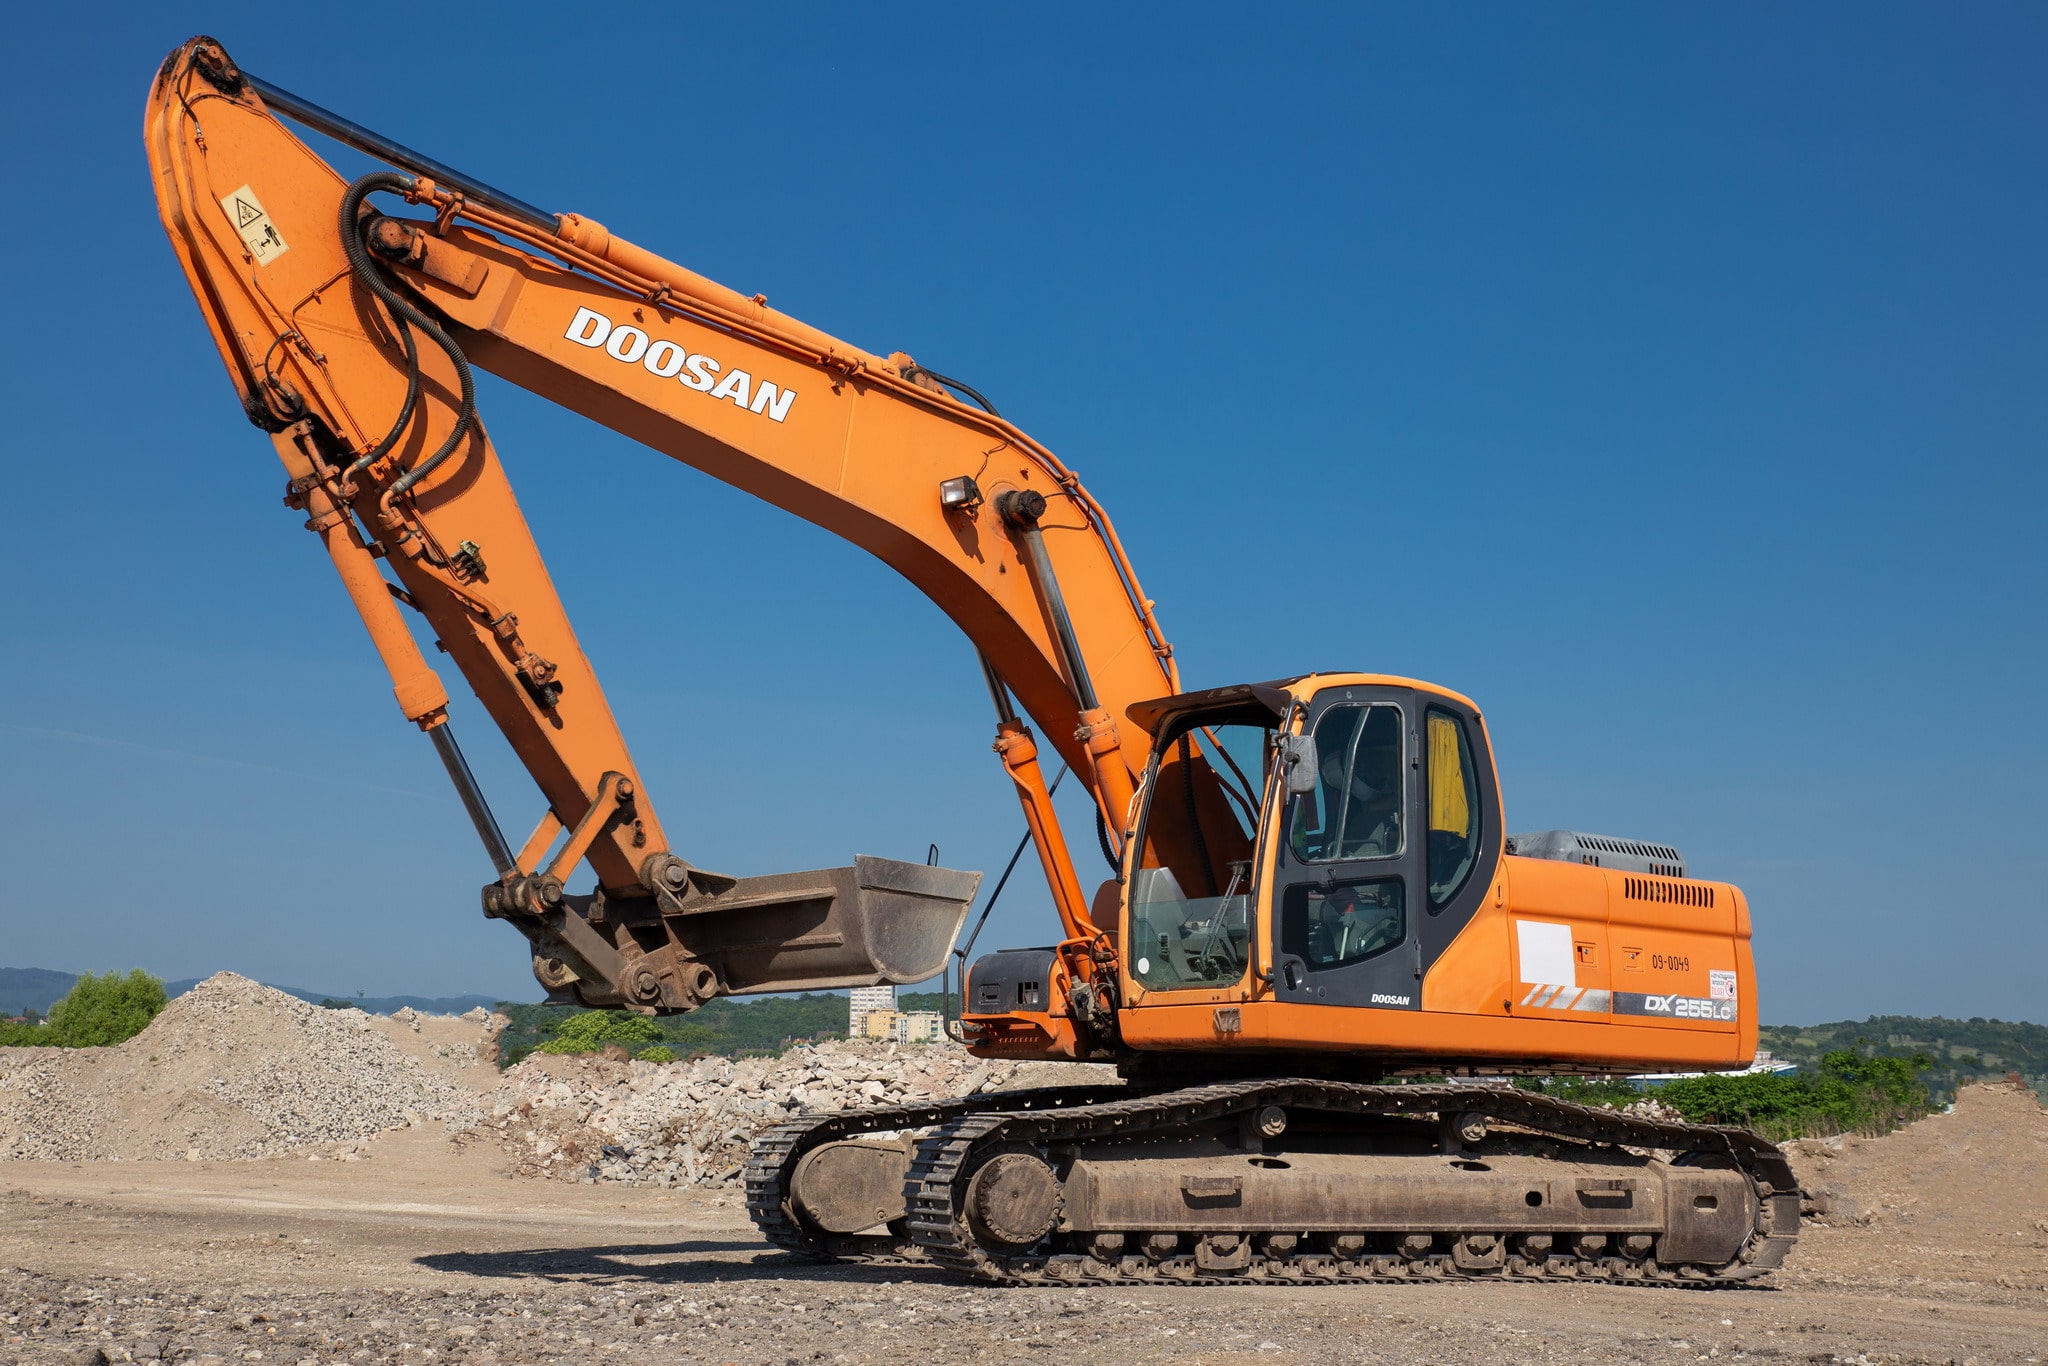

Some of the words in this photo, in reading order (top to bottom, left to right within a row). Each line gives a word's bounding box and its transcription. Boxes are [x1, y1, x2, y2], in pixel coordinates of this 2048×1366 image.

[563, 305, 798, 424] DOOSAN
[1652, 954, 1690, 972] 09-0049
[1371, 993, 1410, 1005] DOOSAN
